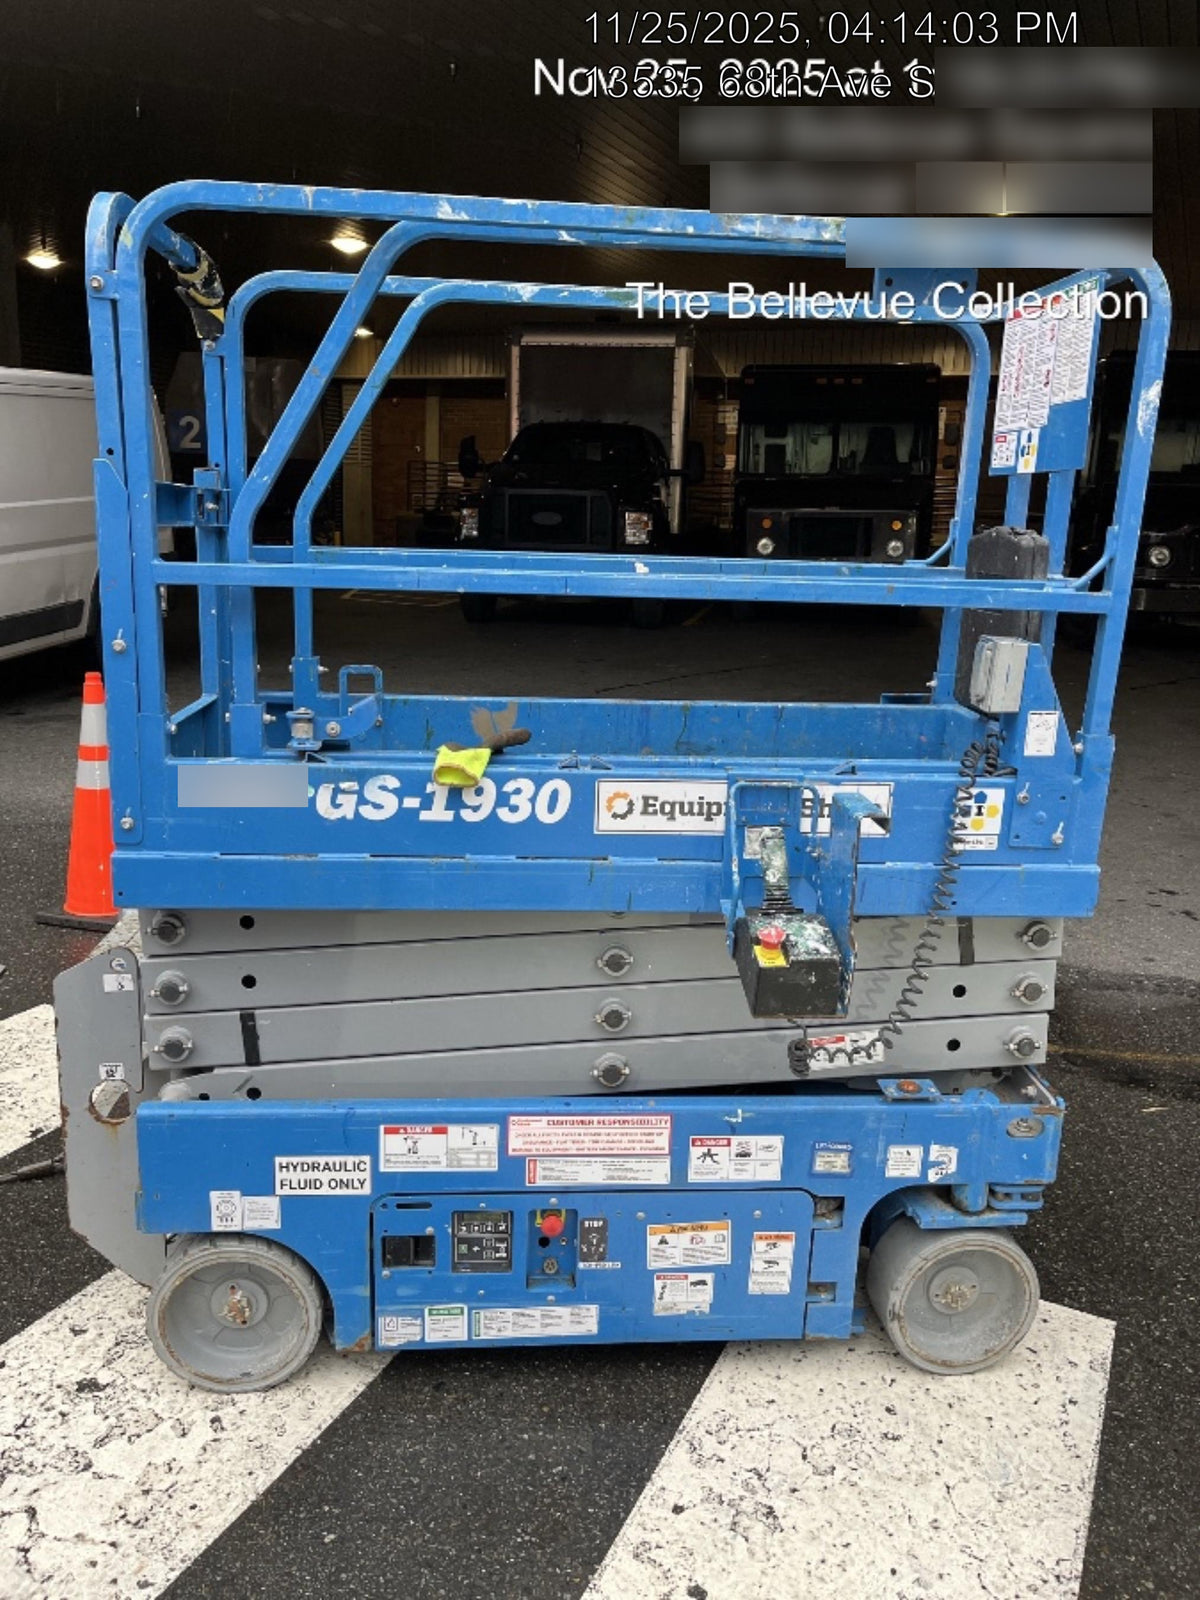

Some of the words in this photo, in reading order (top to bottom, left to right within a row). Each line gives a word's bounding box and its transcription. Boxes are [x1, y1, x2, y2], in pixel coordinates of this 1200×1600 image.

[179, 415, 201, 449] 2
[315, 774, 572, 824] GS-1930
[640, 795, 727, 821] Equip
[279, 1161, 367, 1173] HYDRAULIC
[280, 1179, 323, 1190] FLUID
[328, 1178, 367, 1190] ONLY
